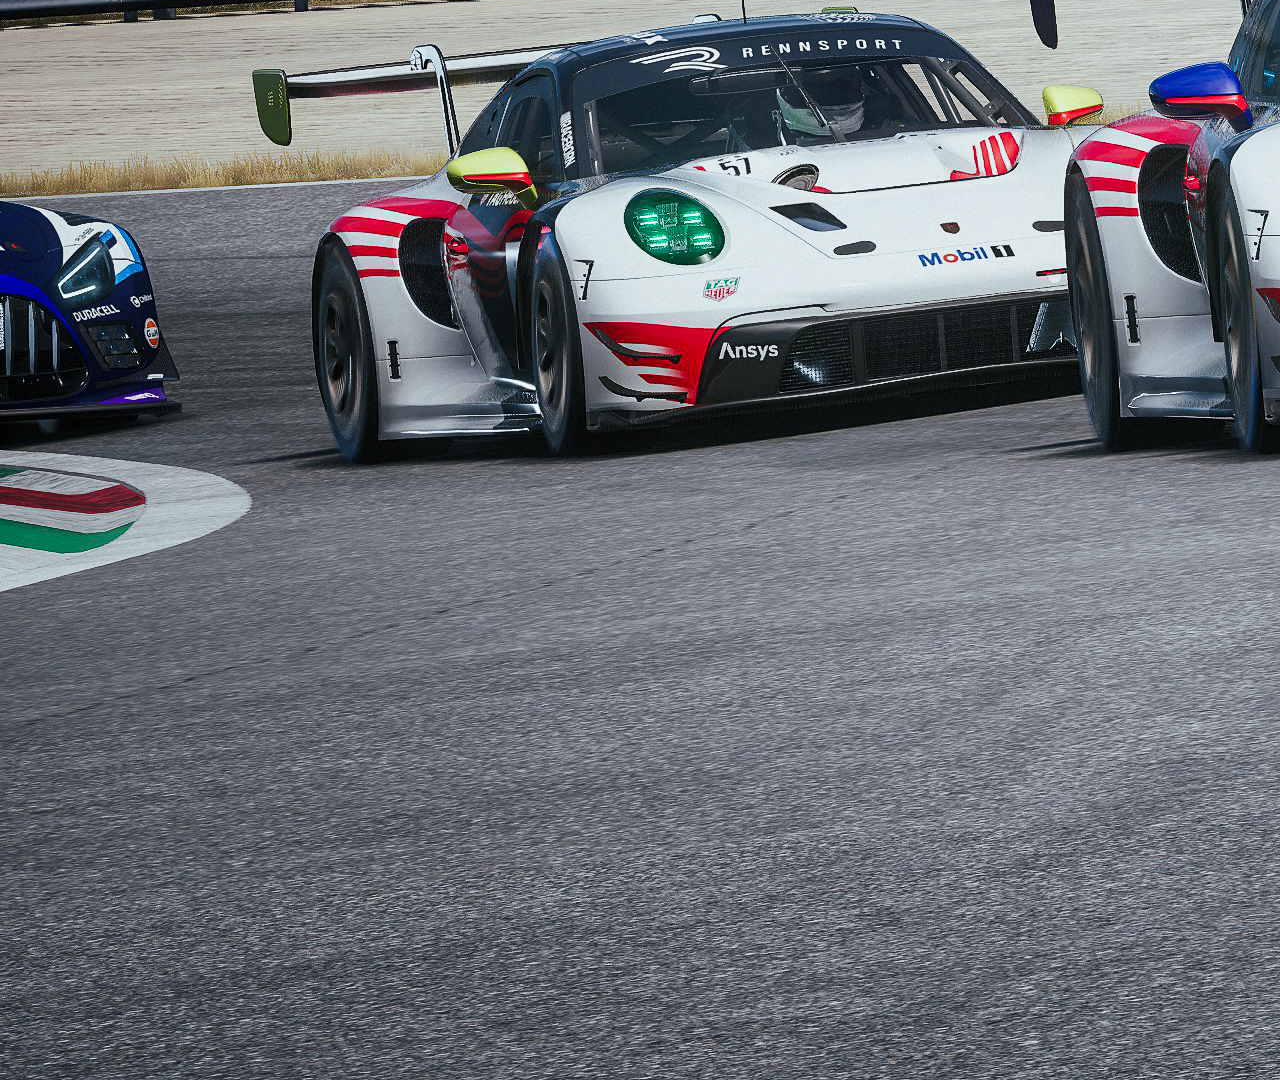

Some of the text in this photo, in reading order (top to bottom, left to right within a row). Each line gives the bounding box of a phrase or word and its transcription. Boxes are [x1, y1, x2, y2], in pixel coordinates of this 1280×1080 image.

[742, 39, 902, 58] RENNSPORT
[718, 156, 752, 177] 57
[918, 244, 1011, 267] Mobil 1
[706, 278, 737, 289] TAG
[73, 304, 121, 322] DURACELL
[718, 341, 779, 361] Ansys
